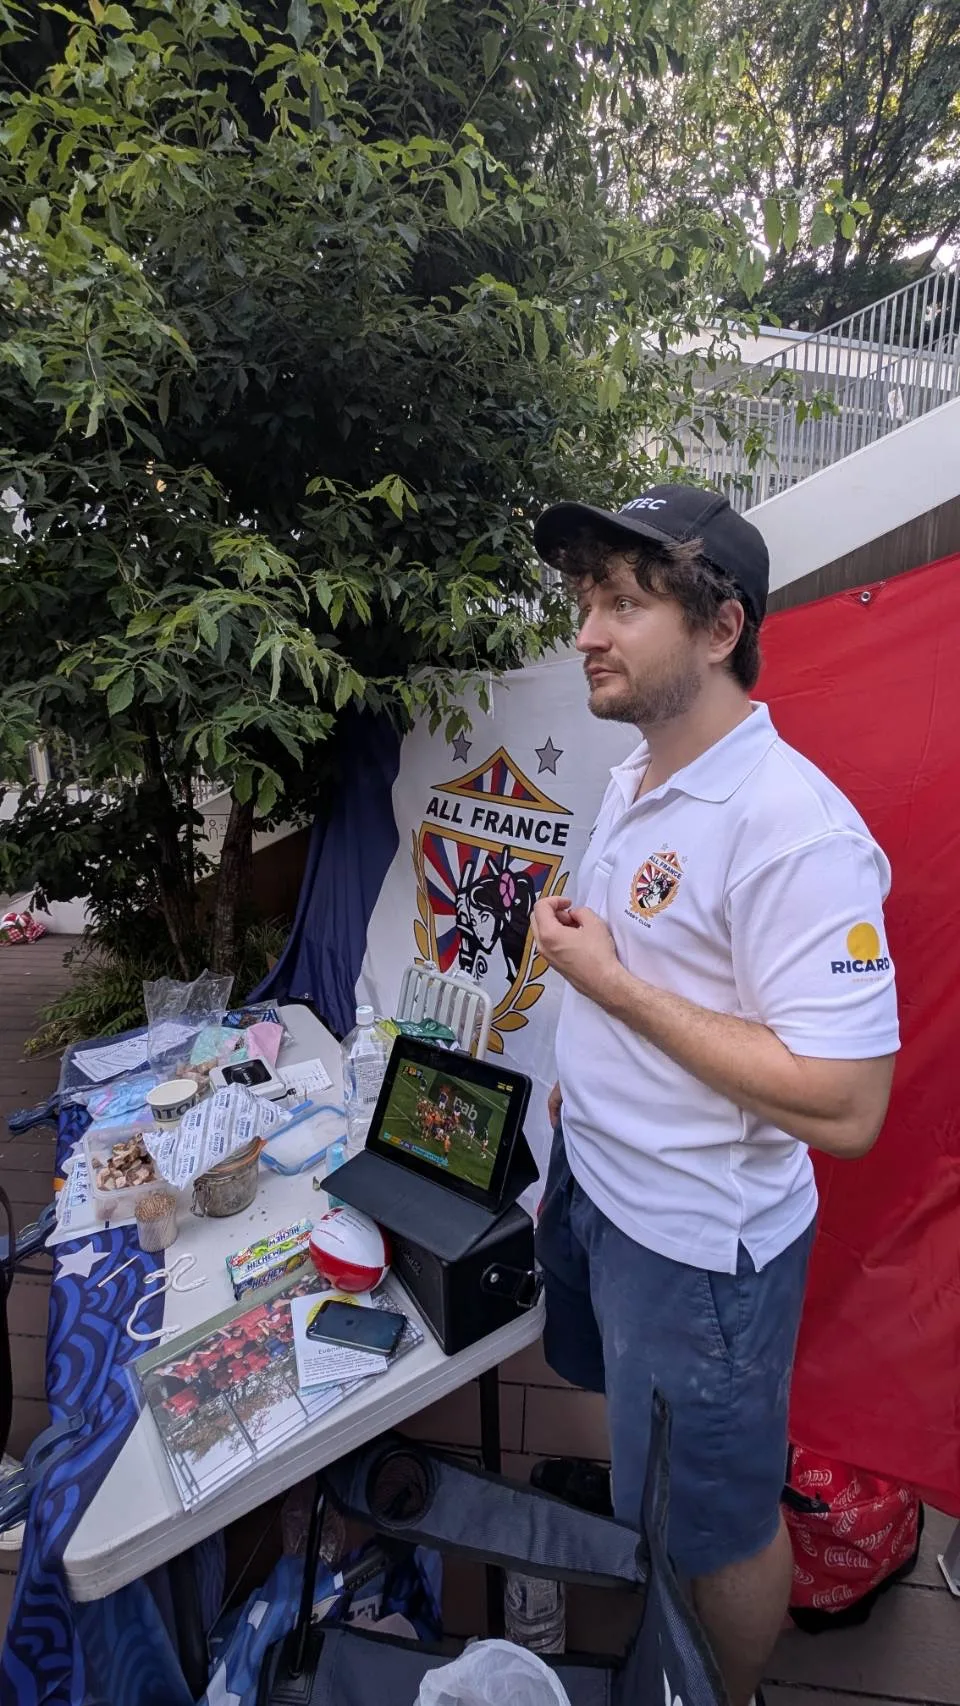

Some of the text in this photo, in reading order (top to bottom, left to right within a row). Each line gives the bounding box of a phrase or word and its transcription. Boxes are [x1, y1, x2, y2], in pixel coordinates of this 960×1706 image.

[425, 796, 570, 848] ALL FRANCE
[648, 855, 683, 881] ALL FRANCE
[638, 918, 652, 929] CLUB
[830, 957, 890, 974] RICARD
